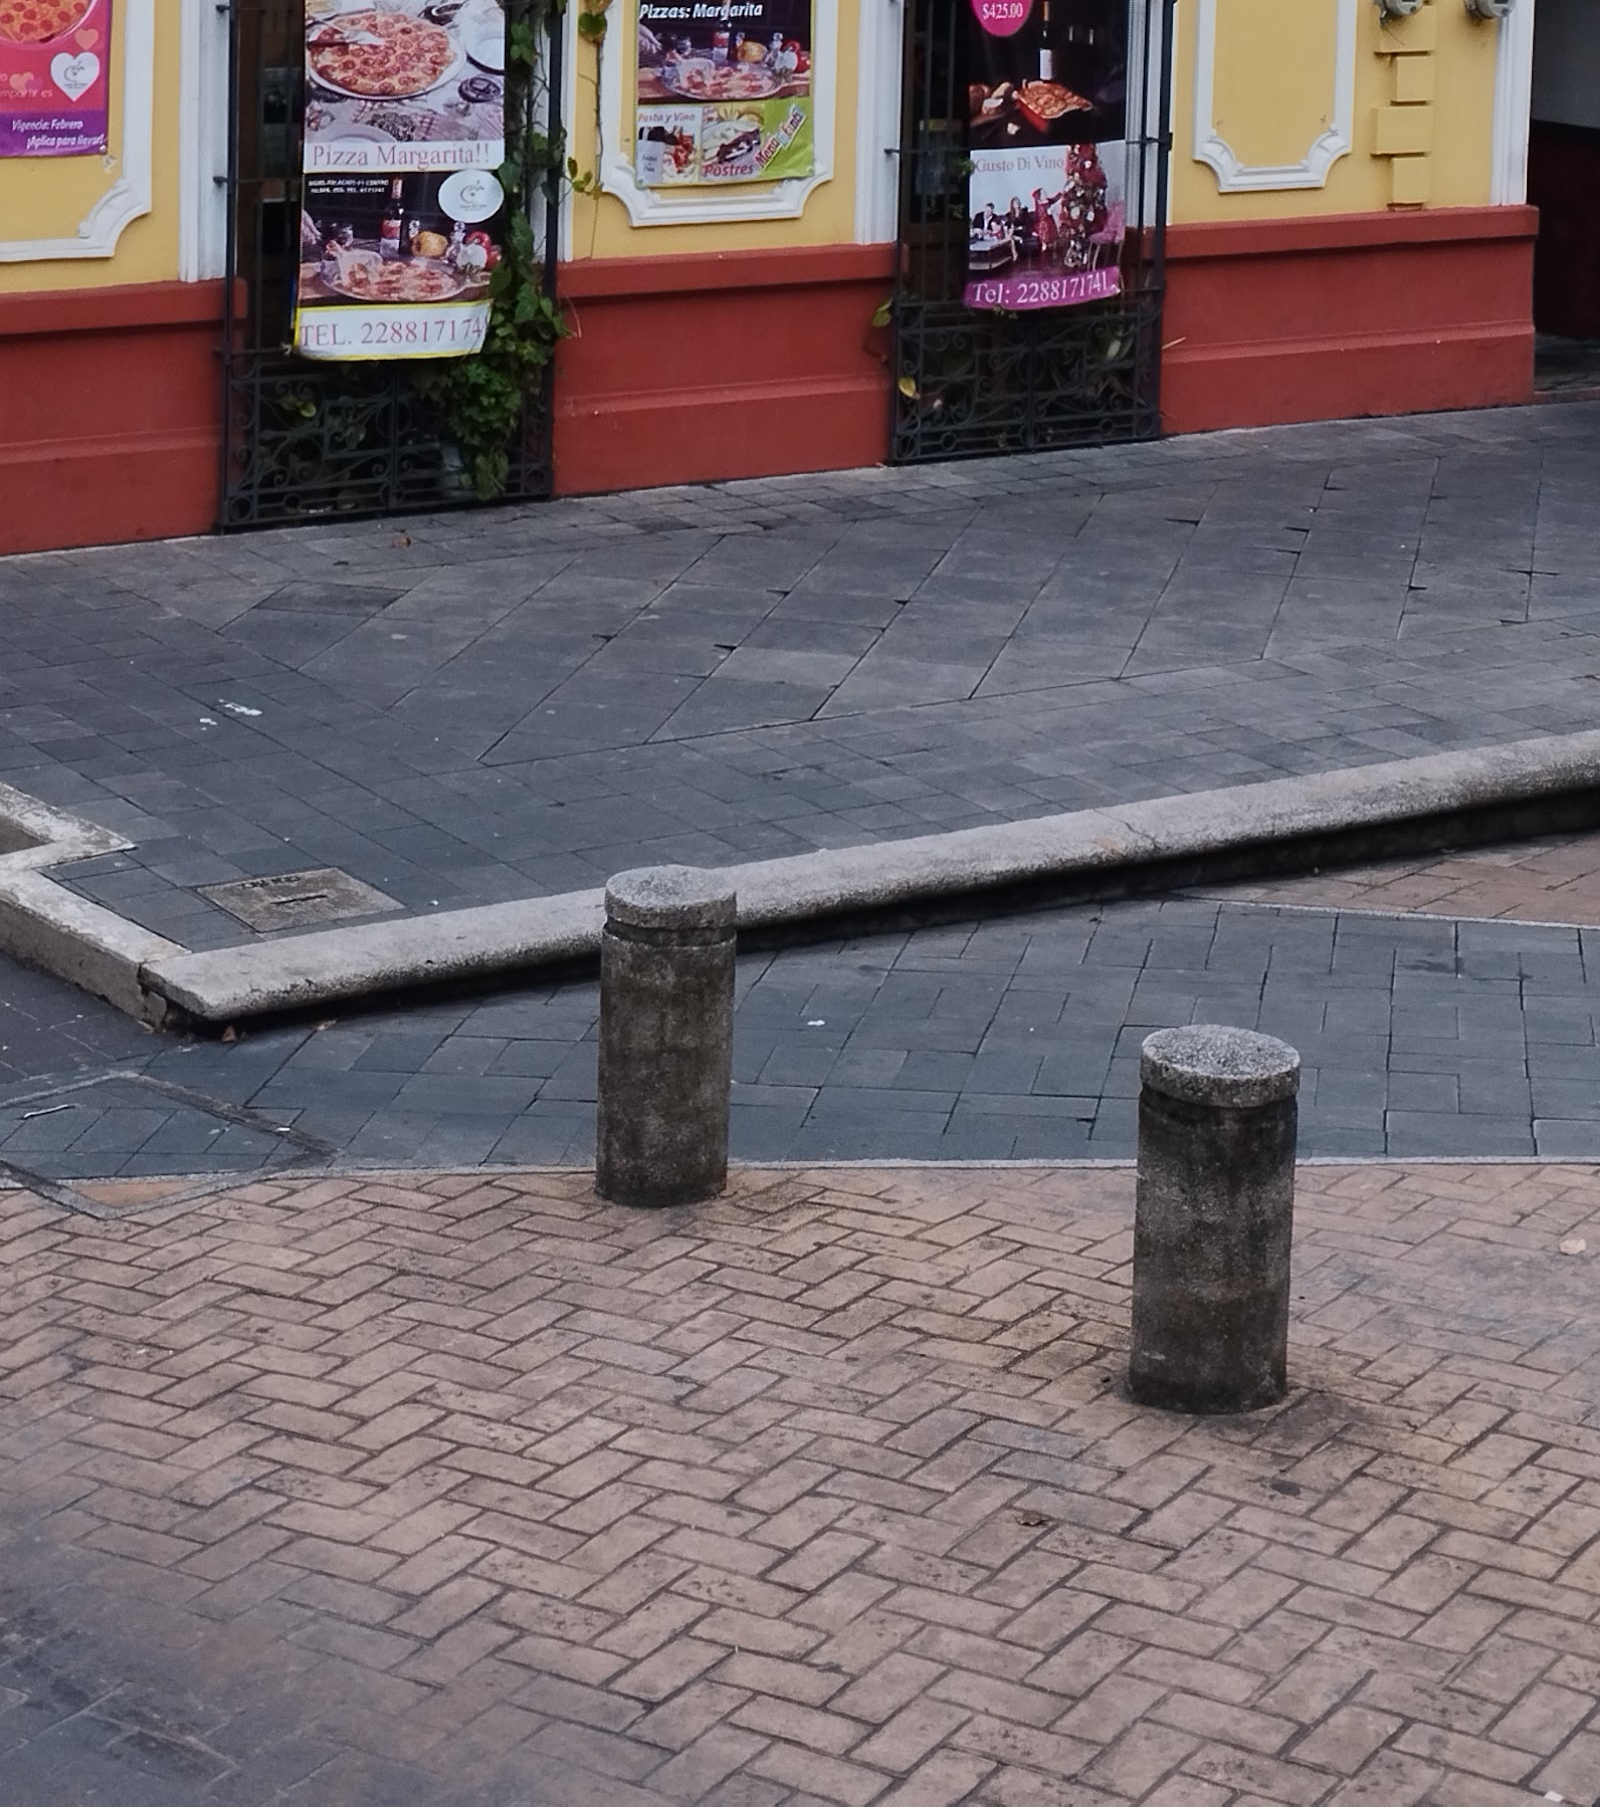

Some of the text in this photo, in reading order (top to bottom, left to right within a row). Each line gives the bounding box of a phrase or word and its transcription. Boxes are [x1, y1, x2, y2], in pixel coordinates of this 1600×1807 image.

[639, 2, 763, 21] Pizzas: Margarita
[982, 2, 1024, 20] $425.00
[51, 118, 83, 130] Febrero
[638, 113, 664, 122] Pasta
[664, 113, 672, 123] y
[673, 112, 696, 122] Vino
[312, 143, 490, 171] Pizza Margarita!!
[975, 155, 1064, 173] Gusto Di Vino
[703, 163, 754, 178] Postres
[972, 272, 1108, 304] Tel: 2288171741
[300, 323, 352, 347] TEL.
